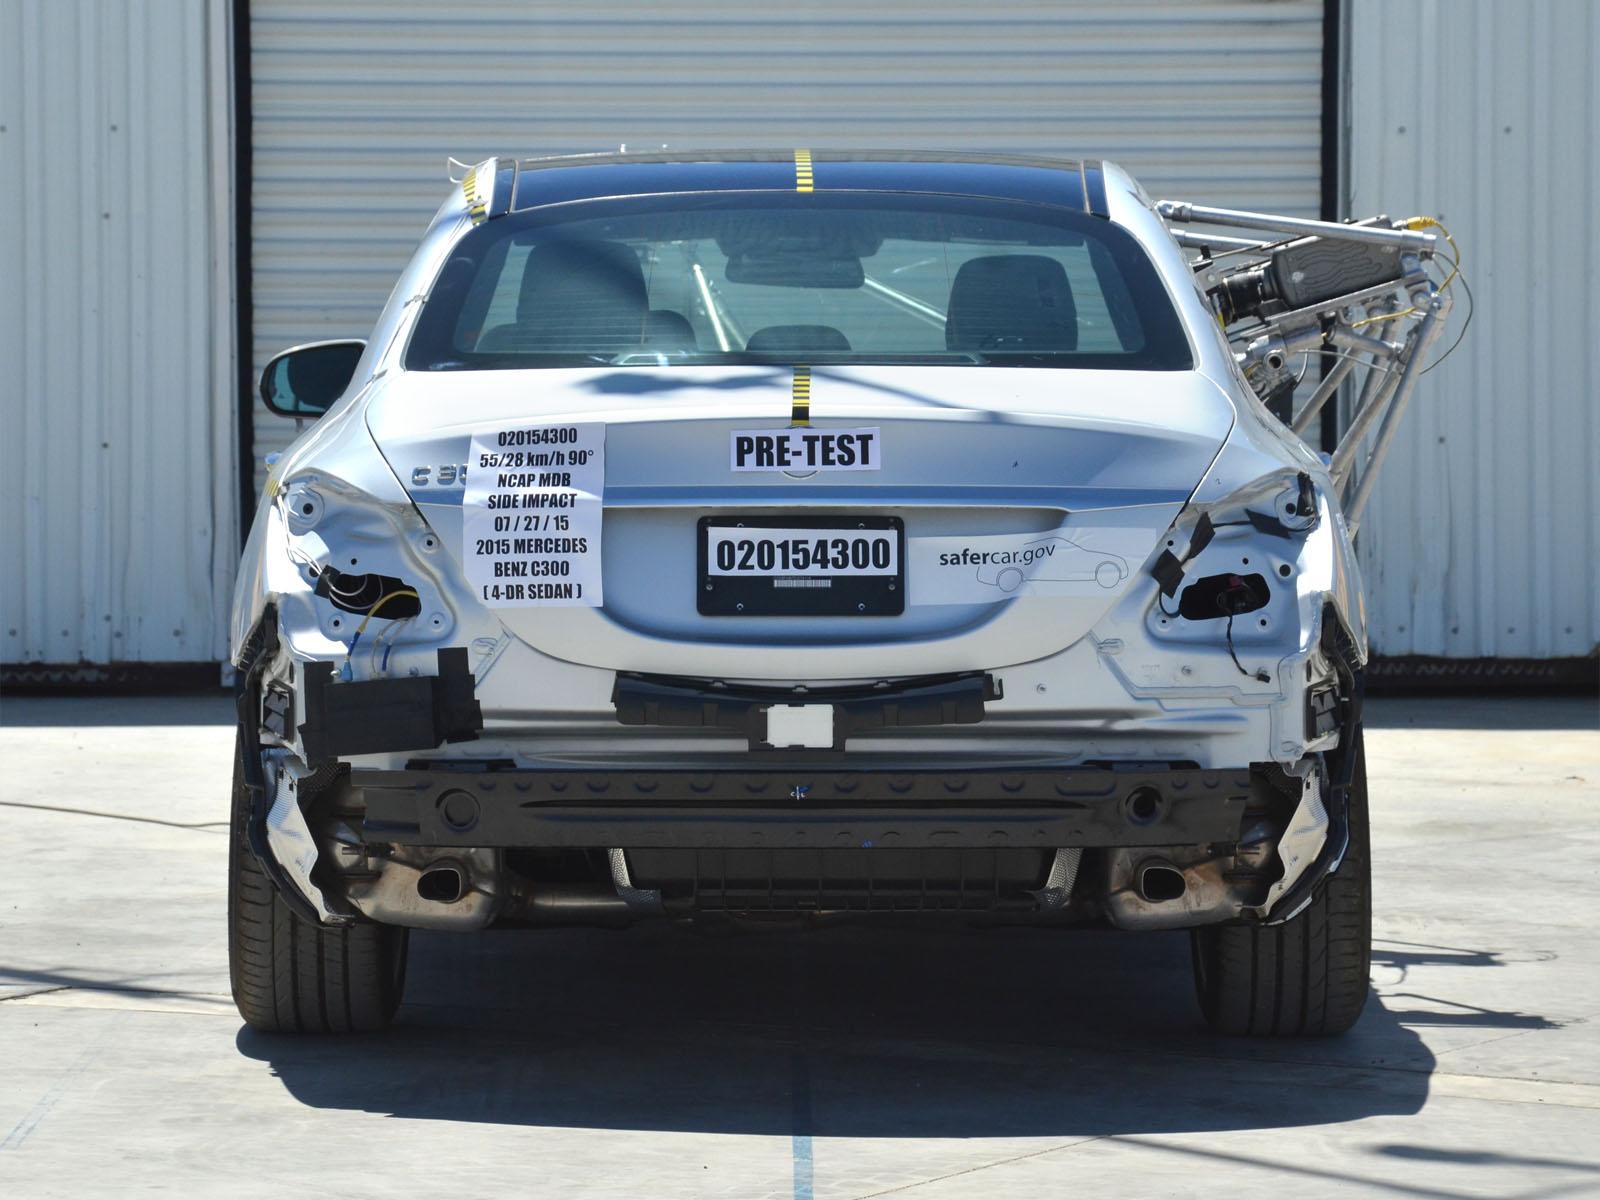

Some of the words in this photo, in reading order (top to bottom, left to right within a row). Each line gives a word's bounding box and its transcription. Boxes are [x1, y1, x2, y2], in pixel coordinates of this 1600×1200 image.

[498, 428, 577, 446] 020154300
[736, 434, 874, 467] PRE-TEST
[480, 452, 523, 468] 55/28
[527, 451, 564, 467] km/h
[497, 473, 536, 487] NCAP
[538, 472, 571, 487] MDB
[487, 494, 519, 509] SIDE
[521, 493, 577, 509] IMPACT
[476, 539, 510, 555] 2015
[514, 537, 588, 554] MERCEDES
[716, 538, 890, 571] 020154300
[939, 544, 1056, 566] safercar.gov
[494, 561, 527, 577] BENZ
[531, 560, 570, 577] C300
[528, 583, 573, 599] SEDAN
